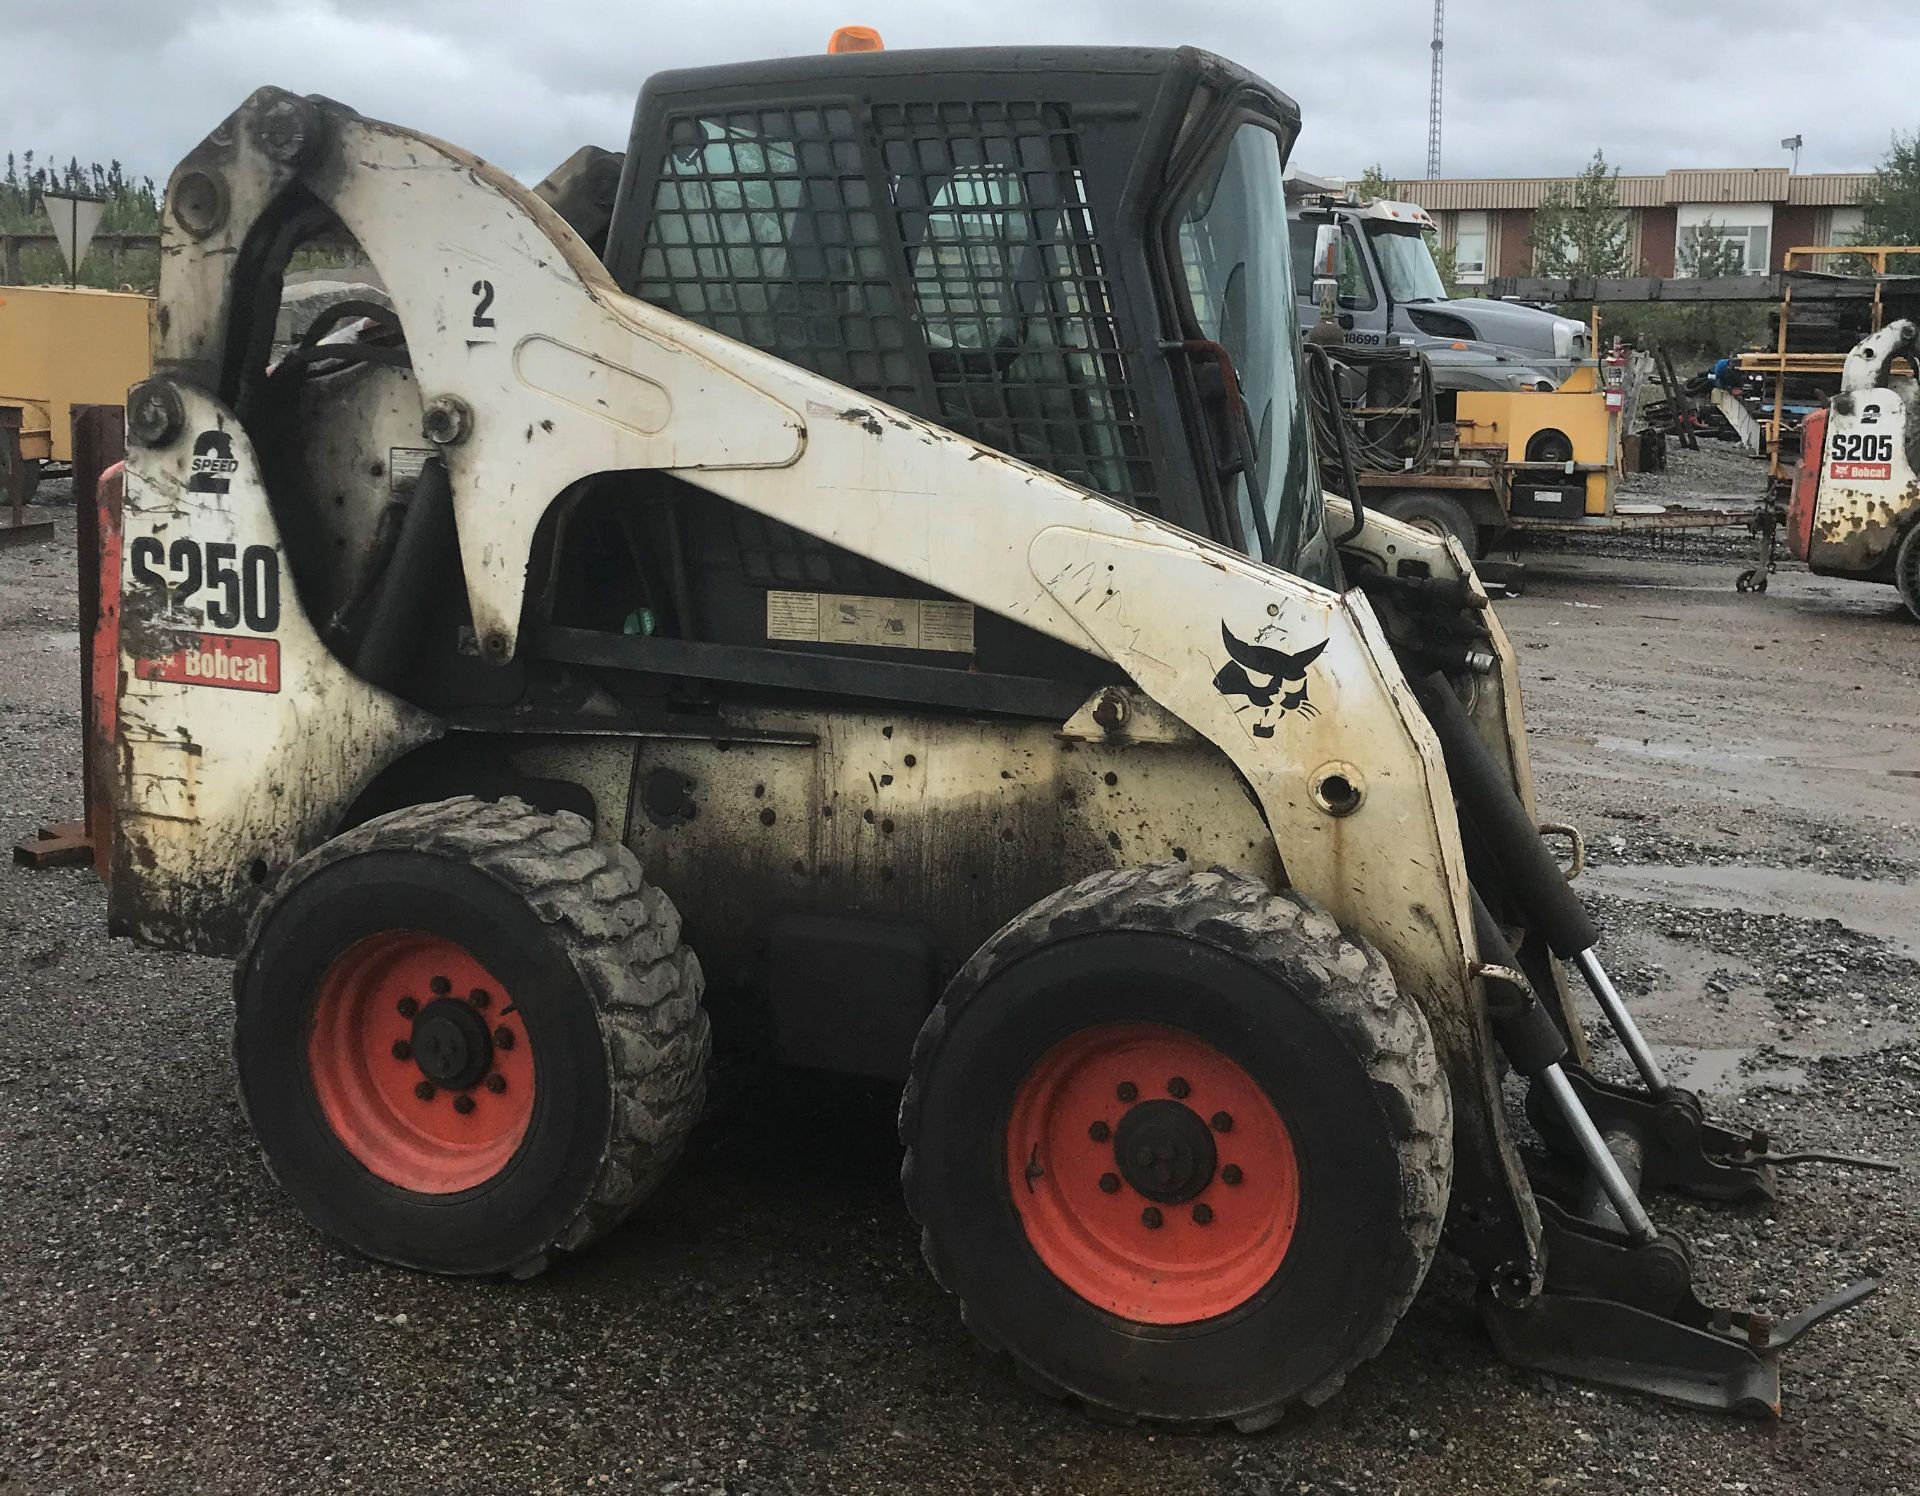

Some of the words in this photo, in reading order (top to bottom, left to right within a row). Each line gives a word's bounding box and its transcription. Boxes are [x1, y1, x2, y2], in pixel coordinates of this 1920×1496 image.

[471, 280, 496, 328] 2
[1344, 333, 1379, 345] 18699
[1861, 404, 1880, 424] 2
[1831, 434, 1892, 461] S205
[188, 430, 235, 494] 2
[191, 458, 239, 472] SPEED
[1851, 466, 1887, 478] Bobcat
[130, 536, 281, 632] S250
[184, 648, 268, 684] Bobcat
